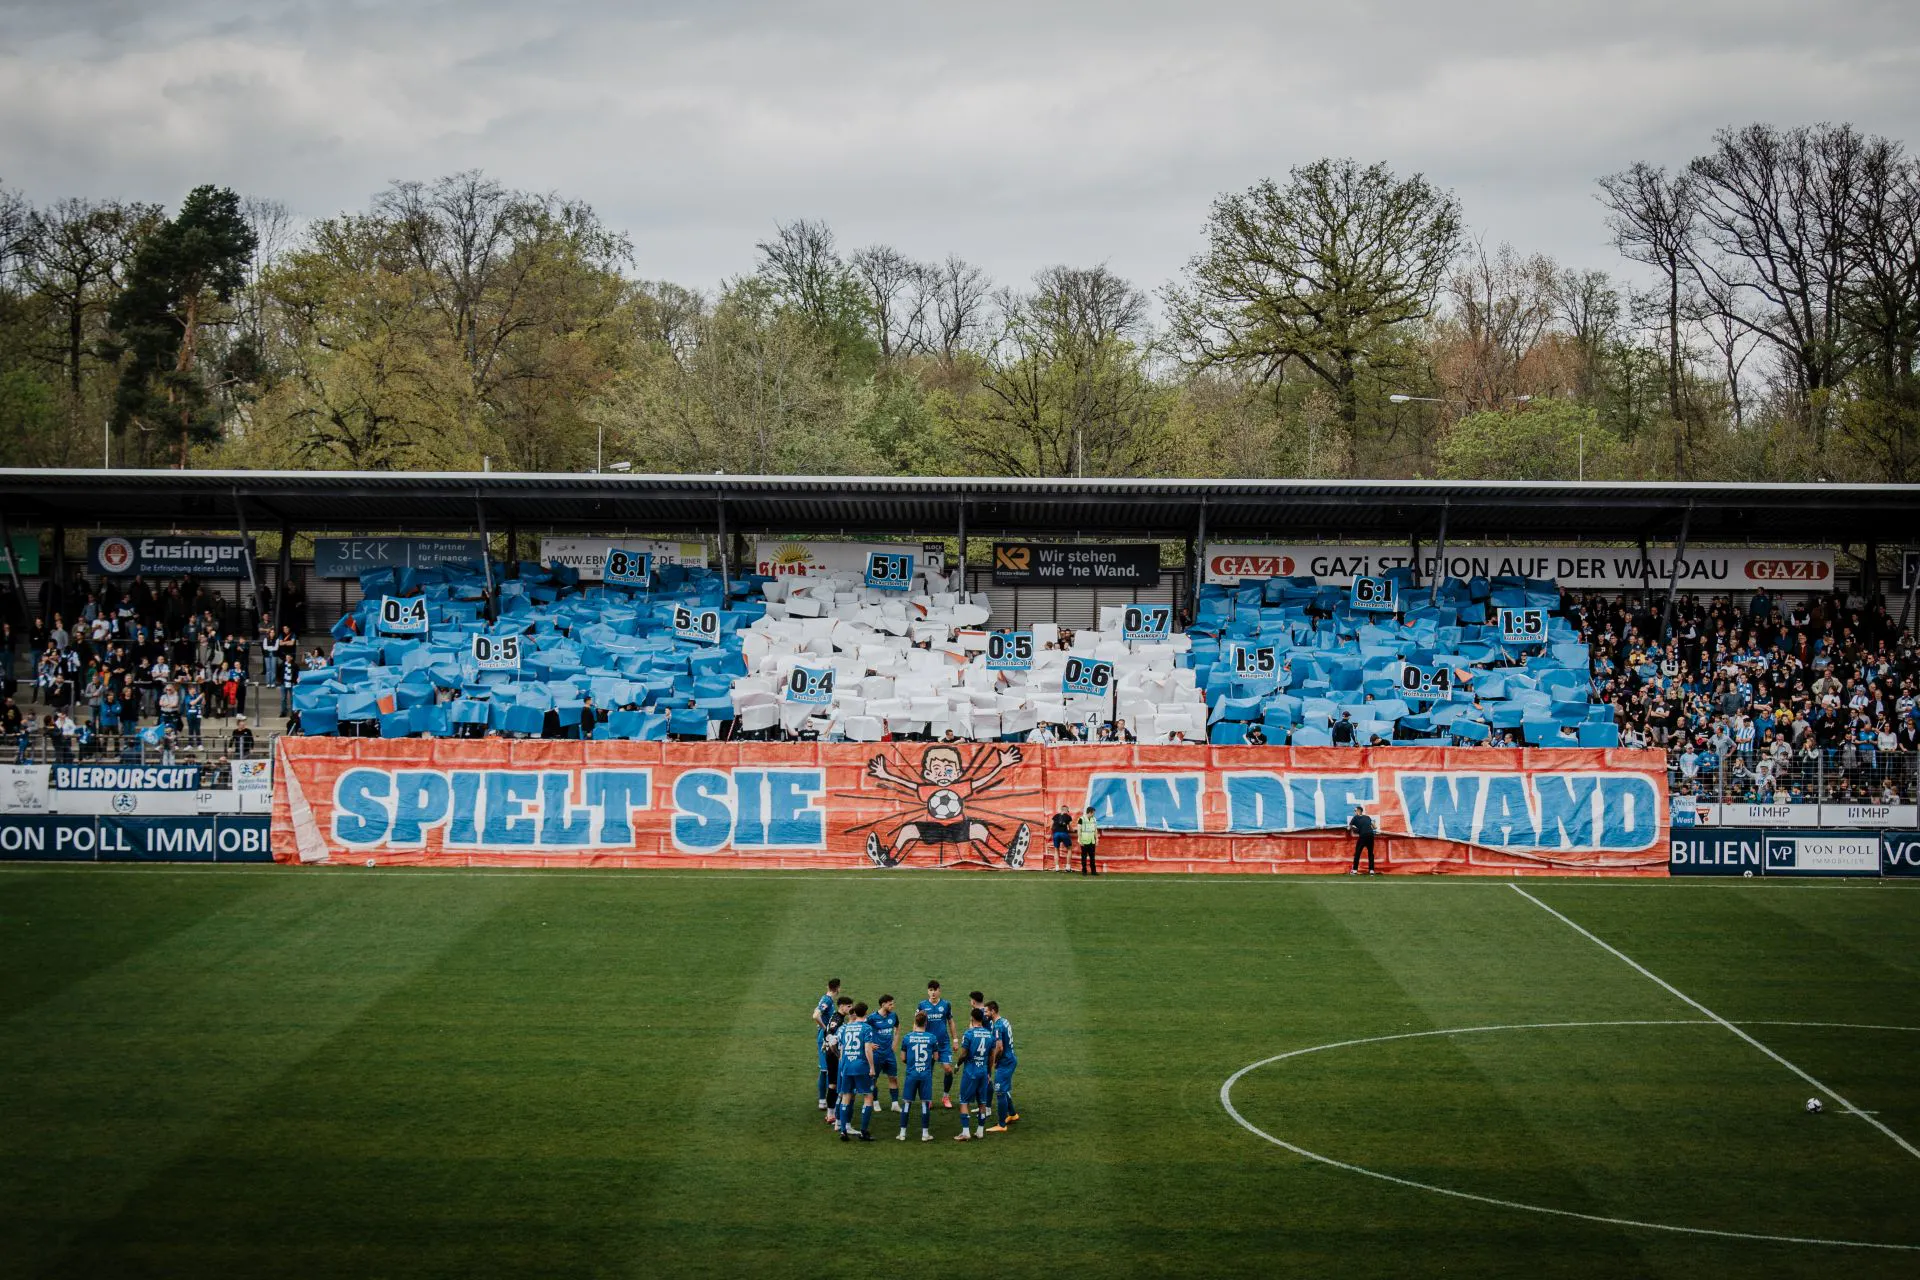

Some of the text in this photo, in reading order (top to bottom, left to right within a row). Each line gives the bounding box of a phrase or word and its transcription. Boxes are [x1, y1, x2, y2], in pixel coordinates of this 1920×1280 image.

[140, 539, 245, 563] Ensinger
[418, 543, 466, 551] Ihr Partner
[418, 554, 472, 562] für Finance-
[1039, 549, 1116, 562] Wir stehen
[140, 564, 151, 572] Die
[153, 564, 192, 573] Erfrischung
[193, 564, 215, 572] deines
[610, 552, 646, 577] 8:1
[872, 555, 908, 580] 5:1
[1039, 564, 1064, 577] wie
[1094, 564, 1140, 577] Wand.
[1310, 556, 1369, 577] GAZi
[1501, 558, 1549, 578] AUF
[1557, 558, 1606, 579] DER
[1613, 559, 1728, 579] WALDAU
[1356, 577, 1393, 602] 6:1
[383, 598, 426, 624] 0:4
[674, 606, 718, 634] 5:0
[1124, 607, 1170, 632] 0:7
[1503, 610, 1543, 634] 1:5
[475, 636, 518, 661] 0:5
[988, 634, 1033, 660] 0:5
[1236, 646, 1276, 672] 1:5
[791, 668, 834, 694] 0:4
[1065, 658, 1111, 688] 0:6
[1402, 666, 1451, 691] 0:4
[1088, 712, 1098, 725] 4
[57, 767, 197, 790] BIERDURSCHT
[332, 767, 1661, 854] SPIELT SIE AN DIE WAND
[1762, 807, 1790, 818] MHP
[1861, 807, 1889, 818] MHP
[0, 827, 270, 851] ON POLL IMMOBI
[1805, 845, 1875, 855] VON POLL
[1671, 840, 1760, 864] BILIEN
[1772, 846, 1793, 860] VP
[845, 1031, 861, 1050] 25
[911, 1043, 928, 1062] 15
[977, 1037, 986, 1056] 4
